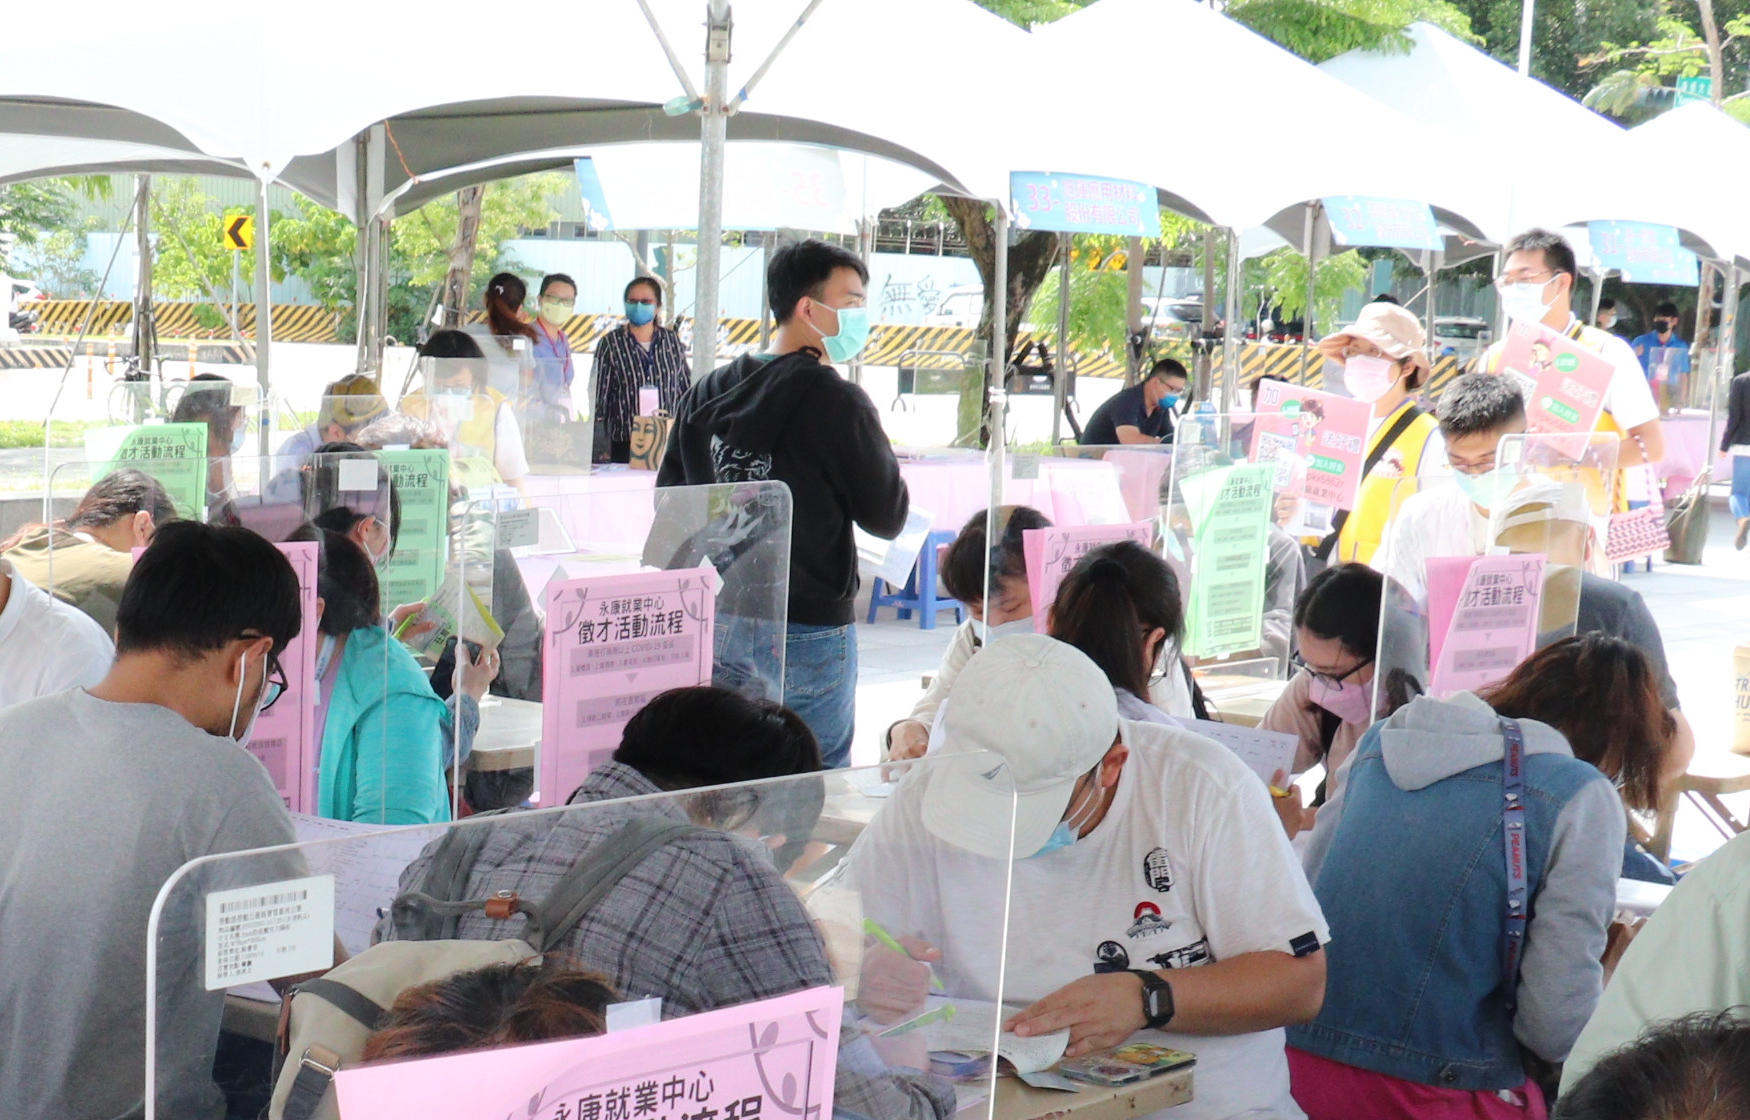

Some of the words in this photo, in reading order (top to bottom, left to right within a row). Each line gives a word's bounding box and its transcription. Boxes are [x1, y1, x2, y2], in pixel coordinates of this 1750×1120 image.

[1065, 202, 1140, 226] 股份有限公司
[1263, 387, 1279, 404] 加
[599, 596, 665, 617] 永康就業中心
[578, 609, 684, 645] 徵才活動流程
[1736, 678, 1750, 692] TR
